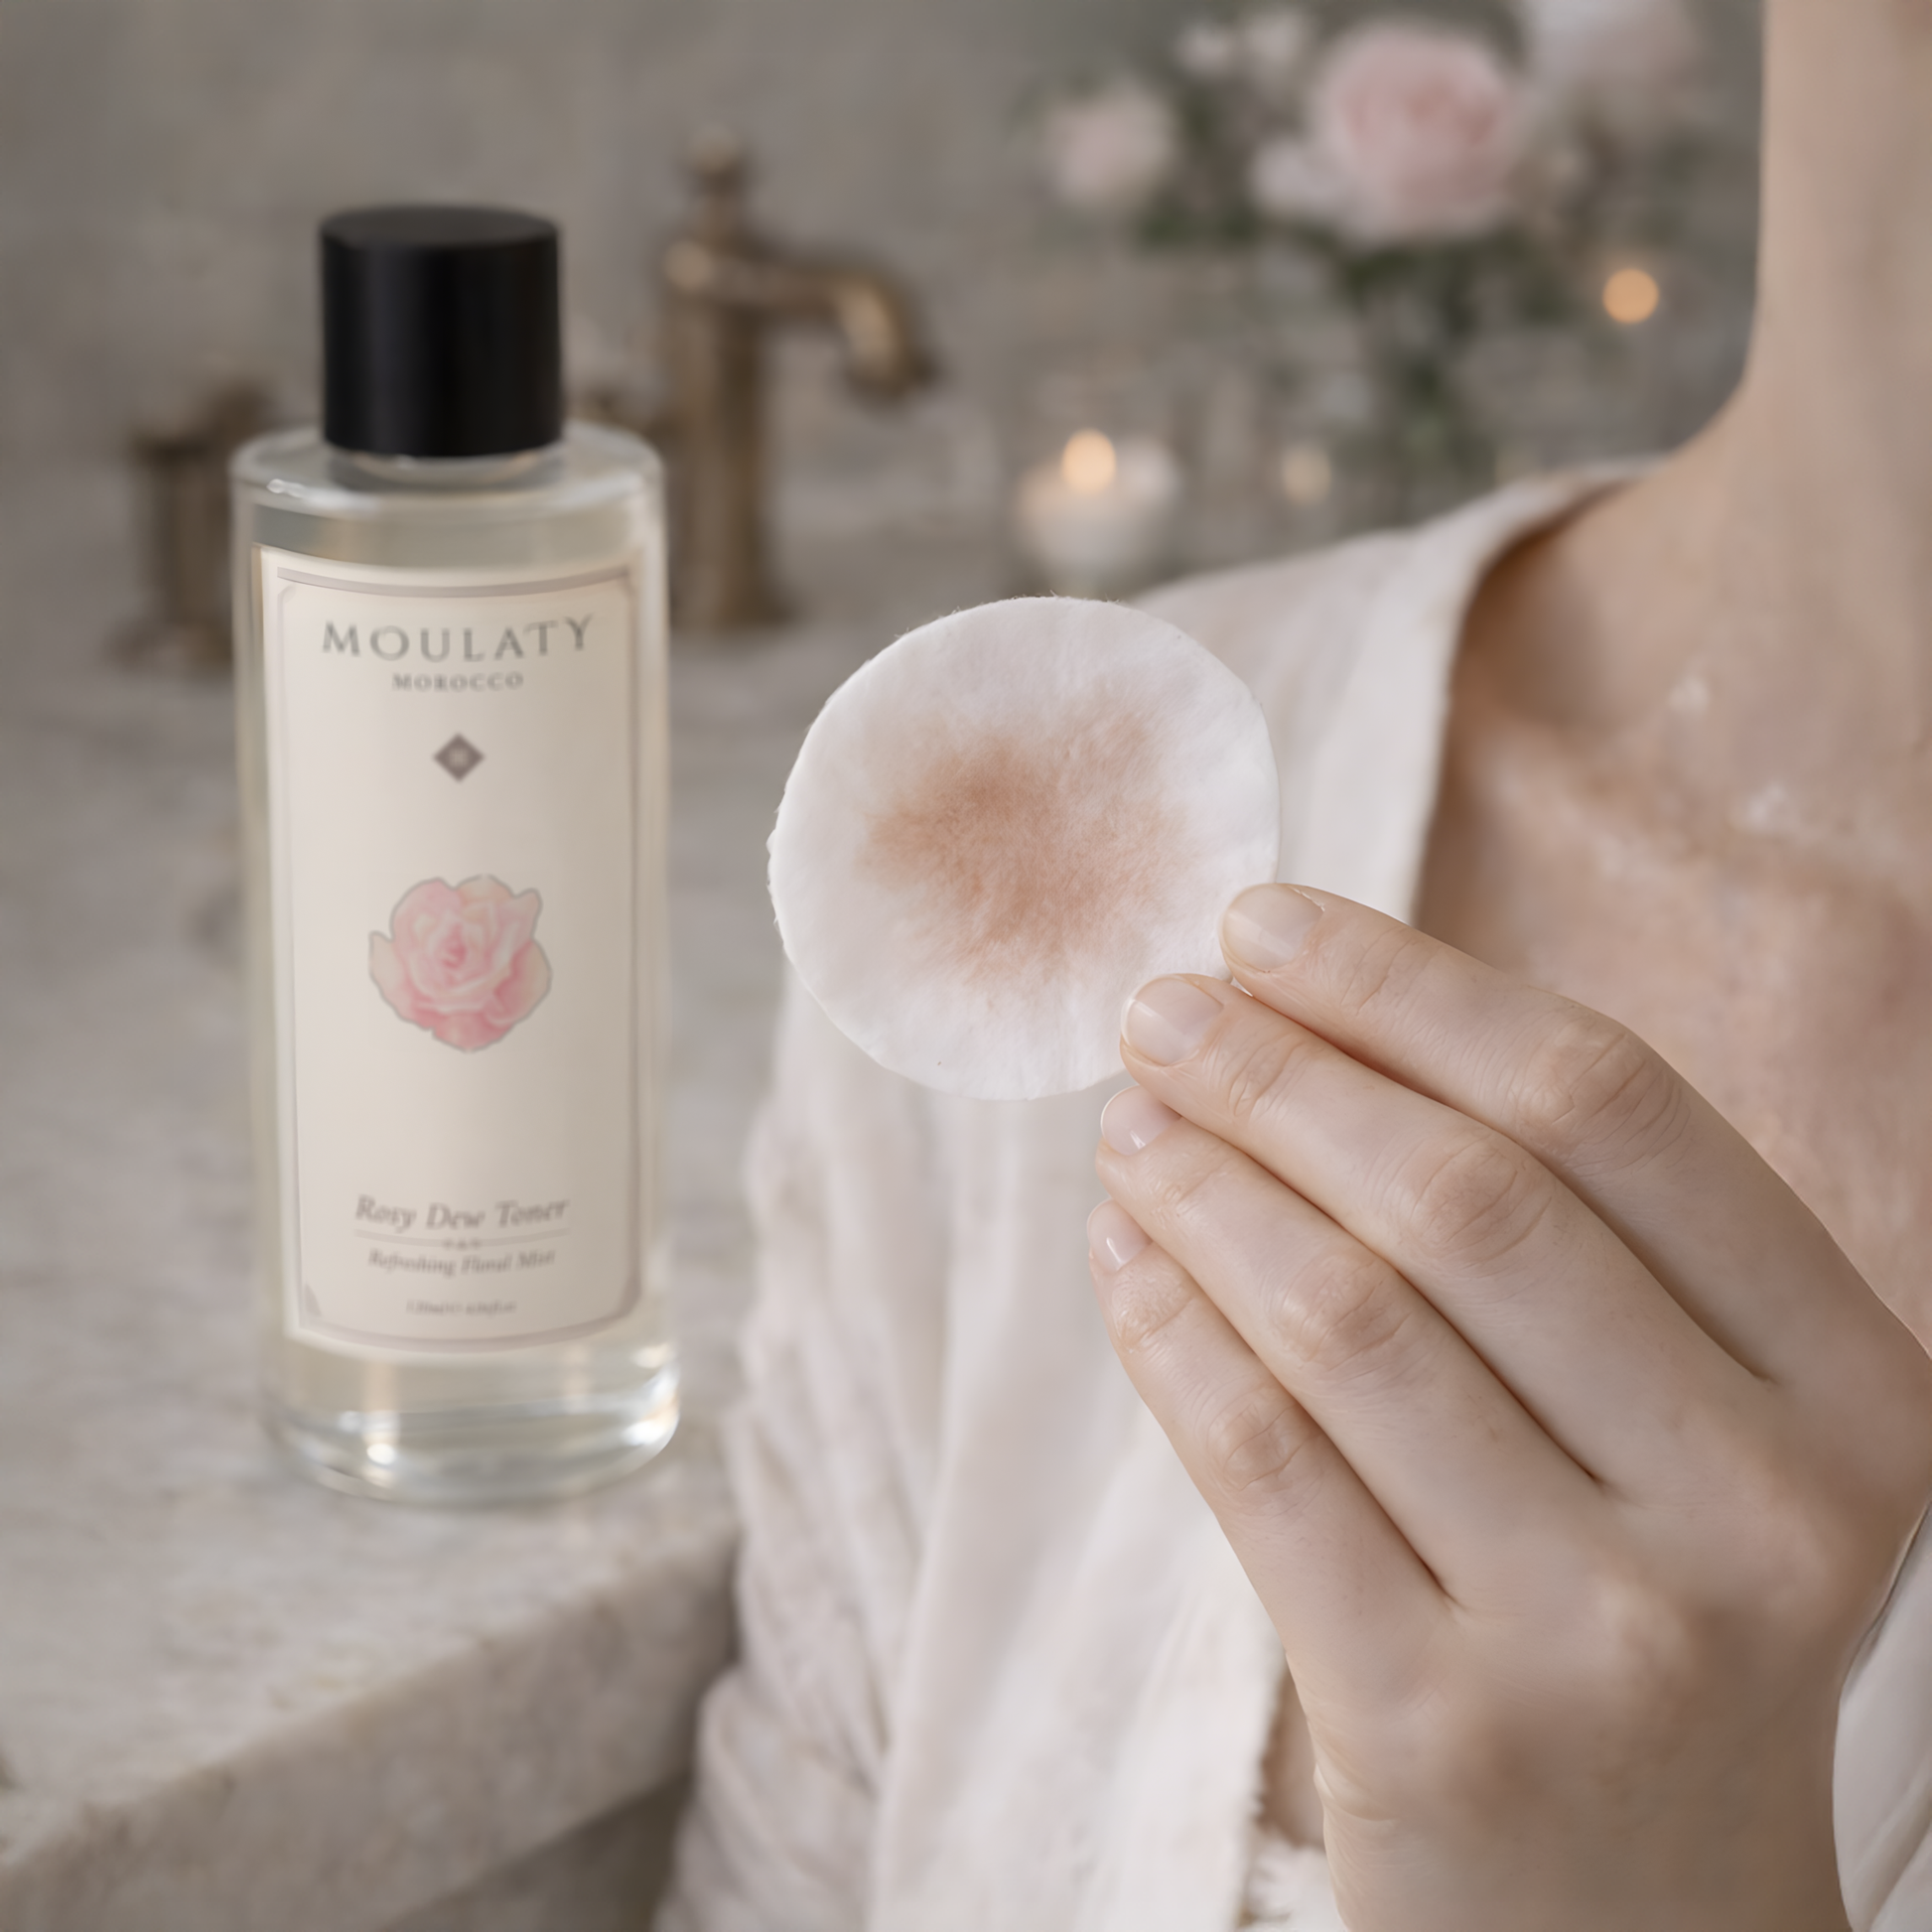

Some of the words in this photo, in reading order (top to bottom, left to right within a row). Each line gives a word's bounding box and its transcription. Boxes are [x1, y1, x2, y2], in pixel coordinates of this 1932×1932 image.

[322, 613, 594, 663] MOULATY
[391, 671, 524, 692] MOROCCO
[355, 1194, 417, 1233] Rosy
[425, 1202, 486, 1230] Dew
[494, 1199, 569, 1228] Toner
